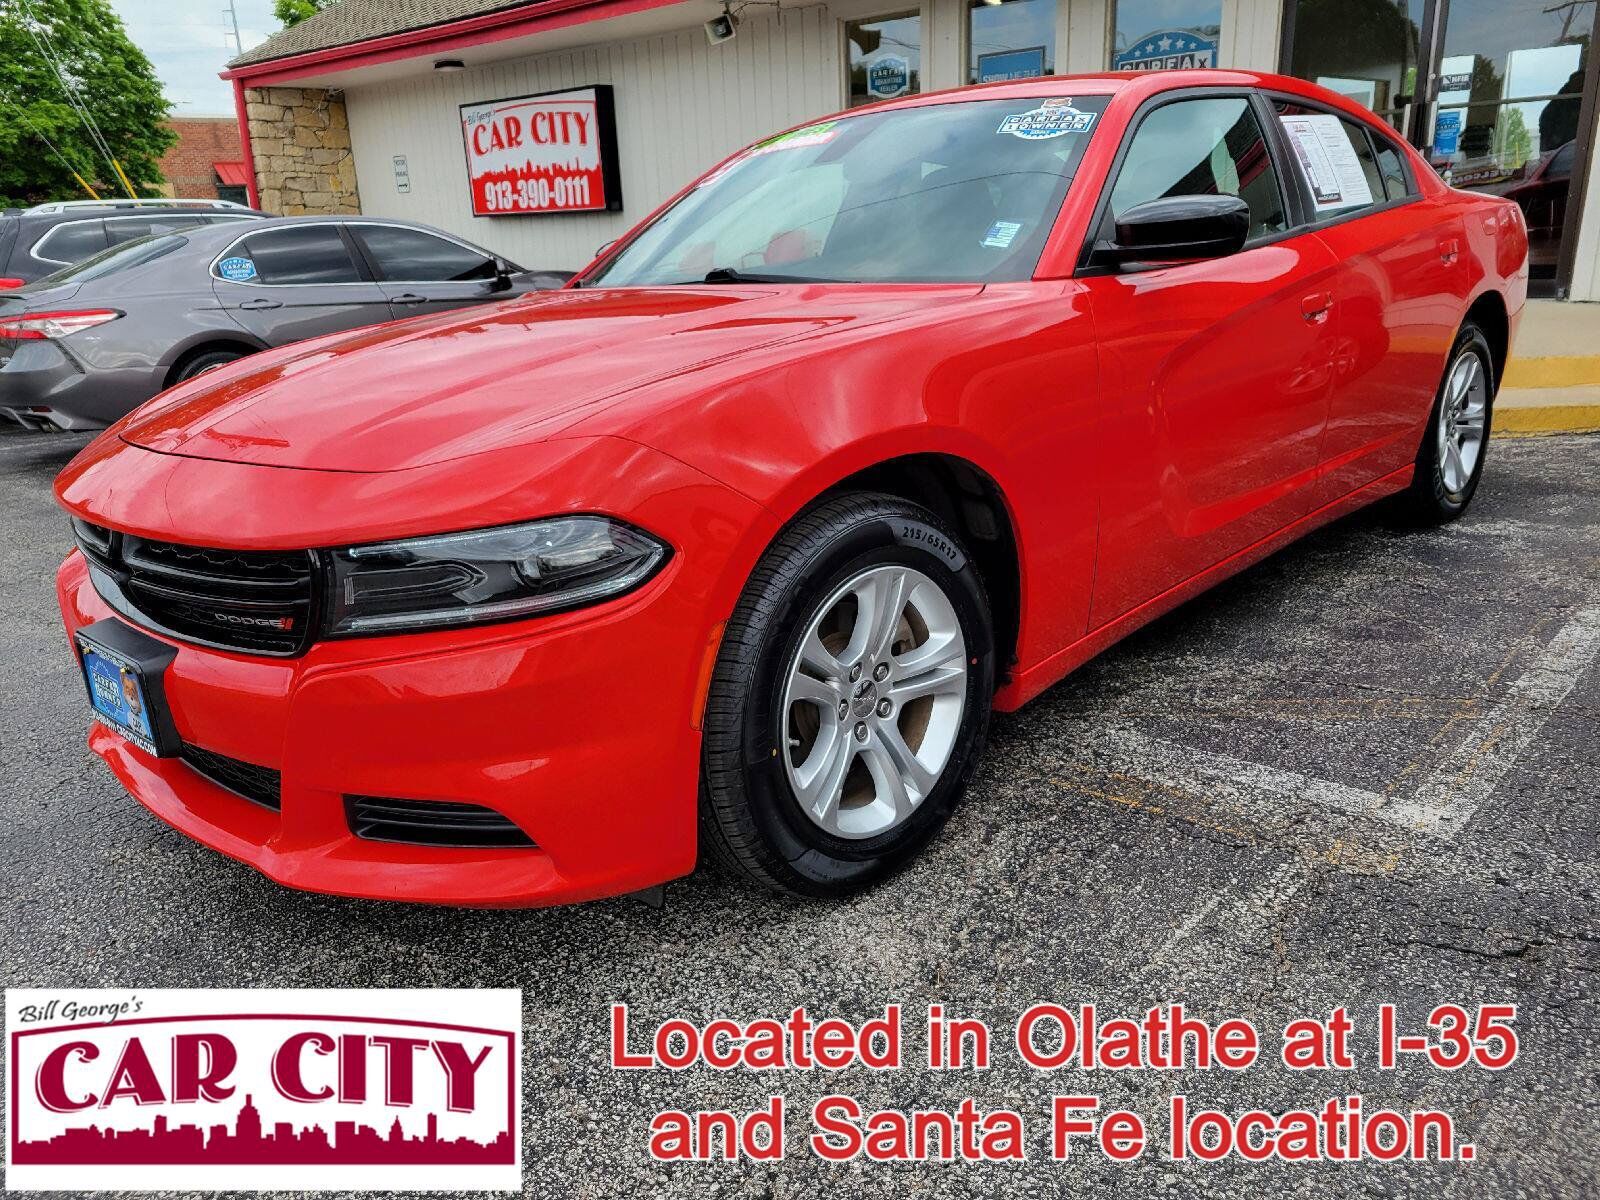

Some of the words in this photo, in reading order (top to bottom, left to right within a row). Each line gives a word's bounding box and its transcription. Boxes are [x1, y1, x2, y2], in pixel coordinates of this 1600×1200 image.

[473, 116, 523, 157] CAR
[530, 111, 591, 145] CITY
[485, 175, 590, 211] 913-390-0111
[903, 526, 957, 560] 215/65R17
[215, 613, 285, 628] DODGE
